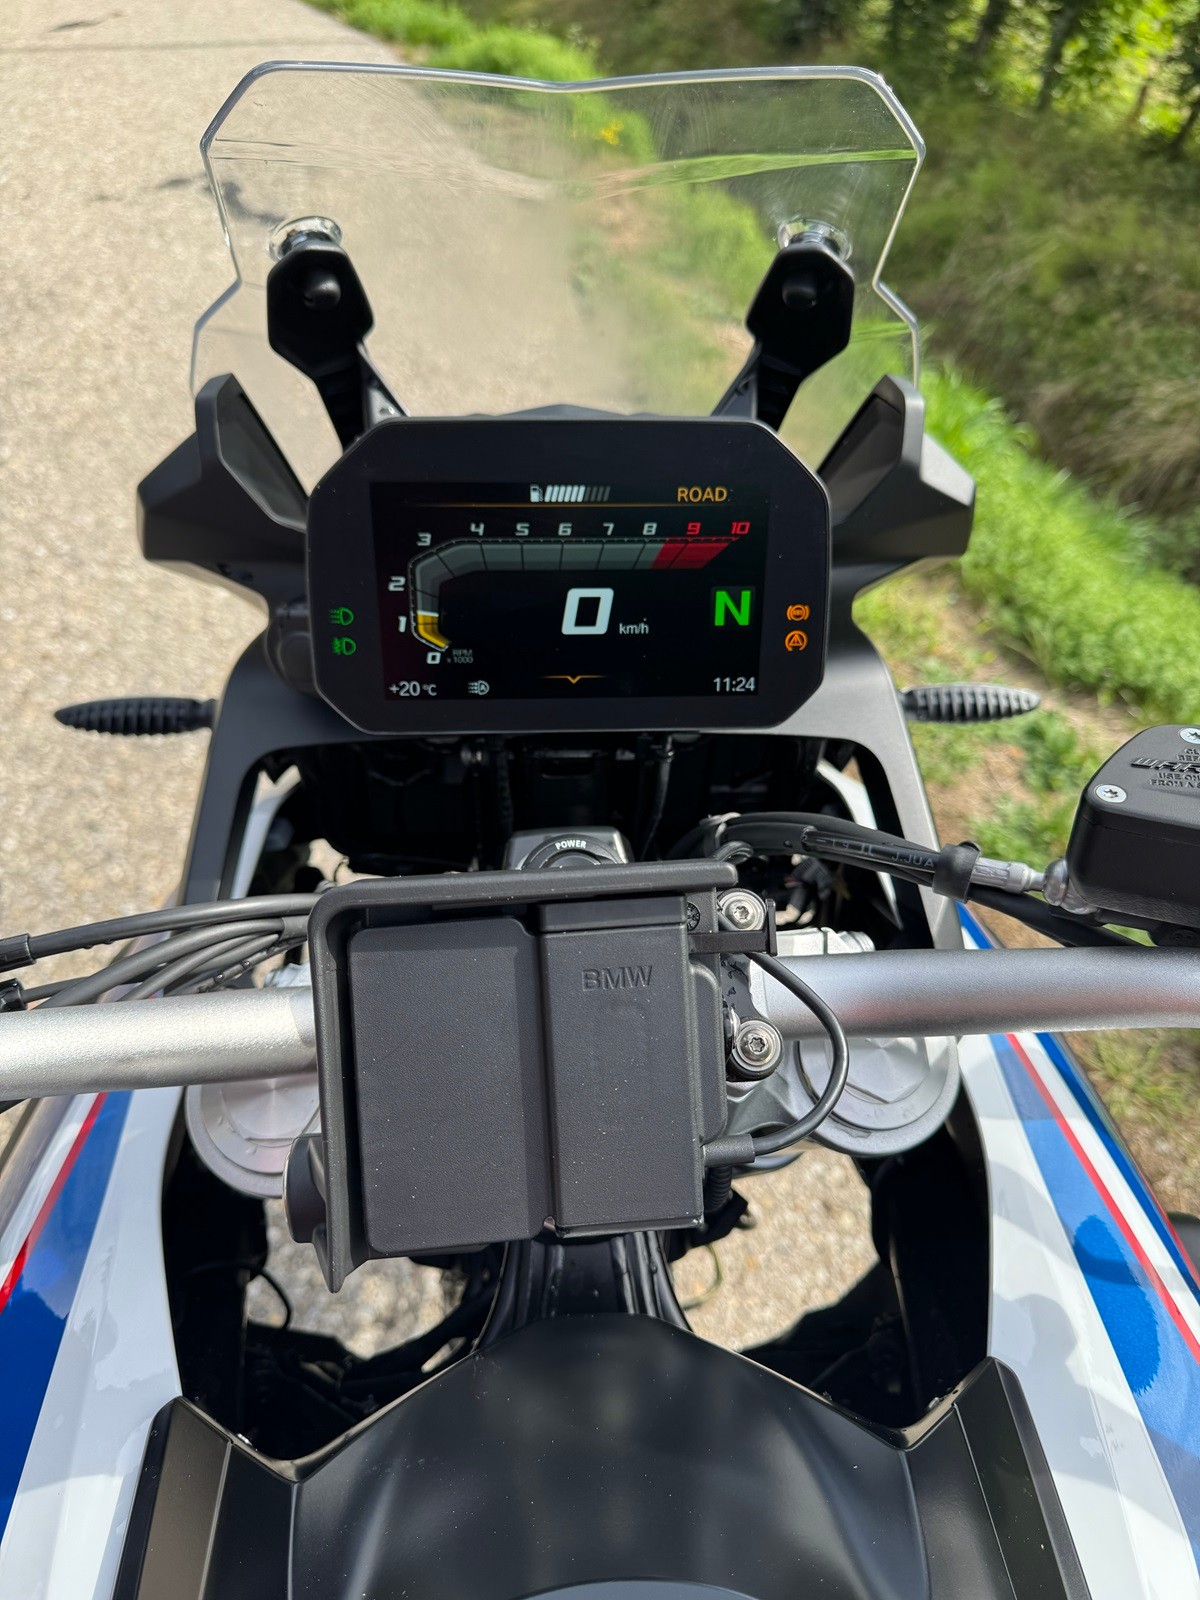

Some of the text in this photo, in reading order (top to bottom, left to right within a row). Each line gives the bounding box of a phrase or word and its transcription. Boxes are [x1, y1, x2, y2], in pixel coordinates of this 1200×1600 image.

[677, 487, 728, 503] ROAD
[470, 521, 751, 536] 4 5 6 7 8 9 10
[416, 532, 432, 547] 3
[388, 576, 406, 592] 2
[560, 587, 650, 636] 0 km/h
[714, 590, 752, 626] N
[397, 615, 407, 633] 1
[426, 651, 442, 665] 0
[452, 649, 473, 657] RPM
[453, 656, 474, 664] 1000
[389, 681, 421, 697] +20
[713, 677, 756, 693] 11:24
[1184, 747, 1200, 756] CL
[1131, 758, 1200, 775] WAR
[1150, 779, 1184, 788] FROM
[554, 838, 588, 851] POWER
[891, 851, 935, 869] J.JUA
[581, 964, 653, 992] BMW
